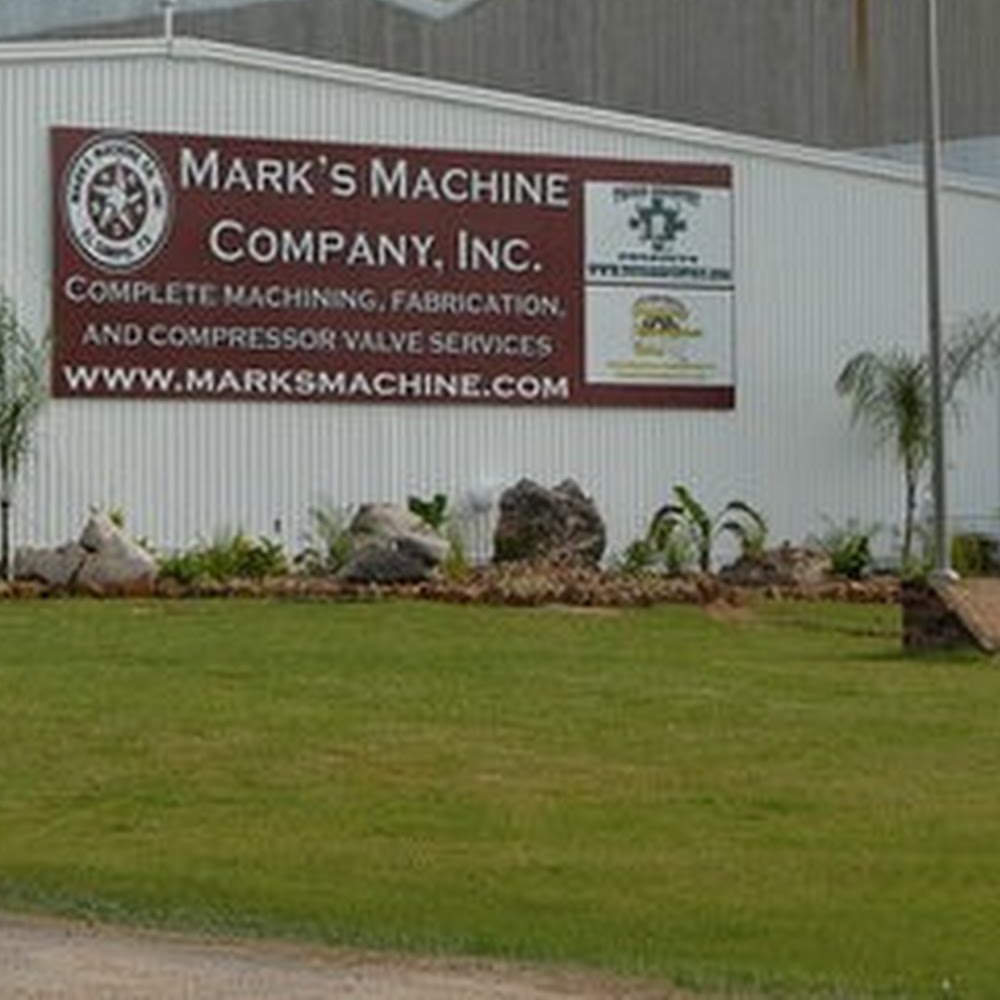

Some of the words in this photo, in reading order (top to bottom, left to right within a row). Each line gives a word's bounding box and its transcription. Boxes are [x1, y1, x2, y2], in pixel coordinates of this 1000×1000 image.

[180, 148, 357, 196] MARK'S
[371, 158, 569, 206] MACHINE
[210, 219, 443, 273] COMPANY,
[458, 229, 542, 272] INC.
[65, 275, 216, 306] COMPLETE
[82, 323, 143, 346] AND
[148, 325, 336, 350] COMPRESSOR
[342, 330, 424, 353] VALVE
[429, 334, 553, 357] SERVICES
[64, 366, 570, 399] WWW.MARKSMACHINE.COM
